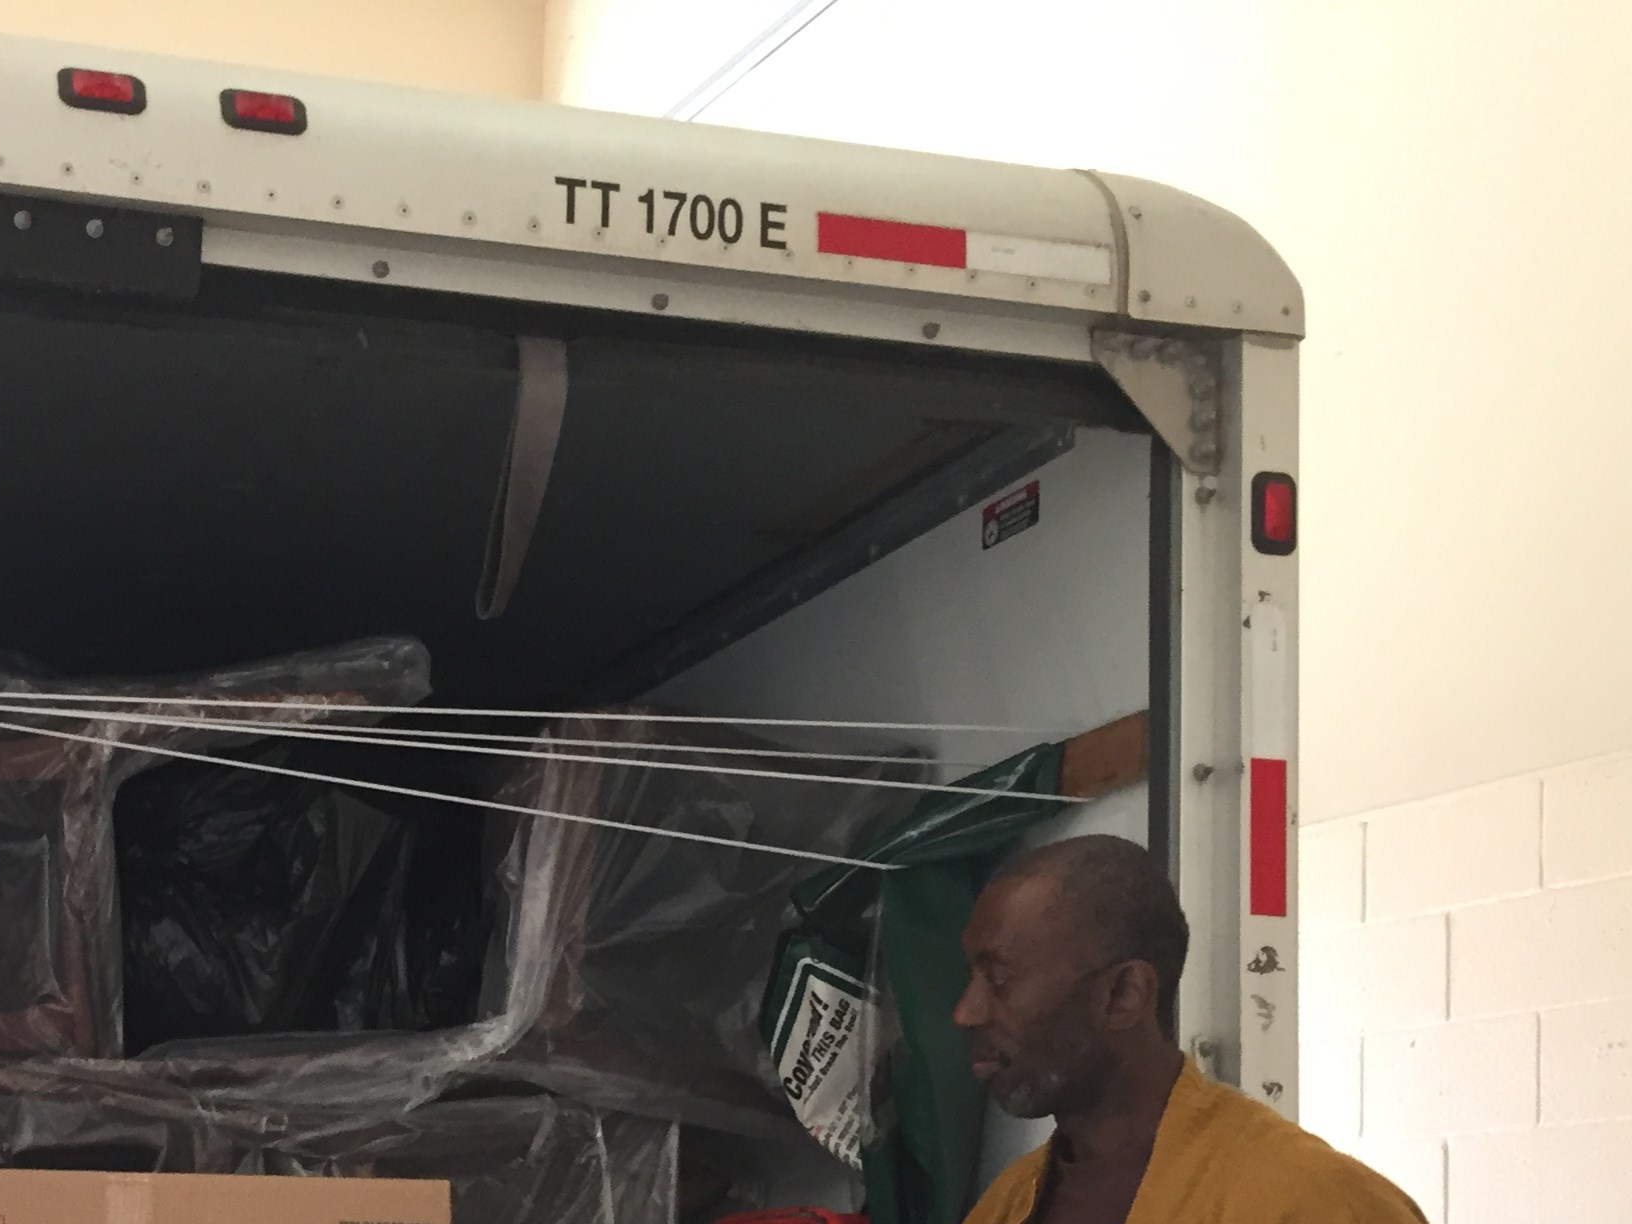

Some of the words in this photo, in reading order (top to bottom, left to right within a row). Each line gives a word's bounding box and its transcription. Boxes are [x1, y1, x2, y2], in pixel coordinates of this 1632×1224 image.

[555, 176, 620, 229] TT
[638, 189, 743, 244] 1700
[759, 202, 787, 250] E
[812, 1031, 835, 1062] THIS
[830, 998, 851, 1031] BAG
